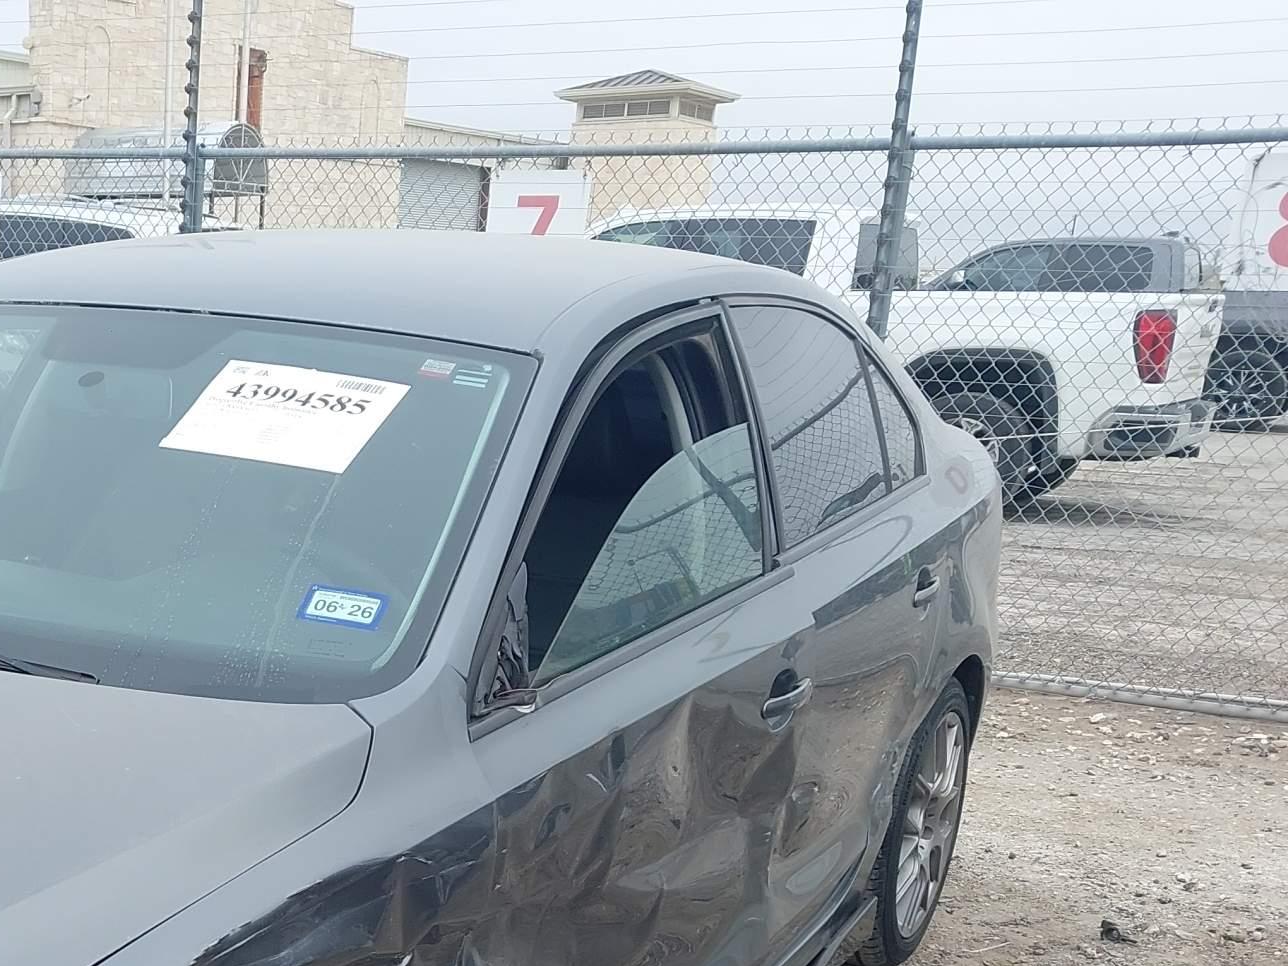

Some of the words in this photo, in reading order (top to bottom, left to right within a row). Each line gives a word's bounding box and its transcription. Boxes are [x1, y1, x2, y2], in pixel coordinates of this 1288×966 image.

[517, 195, 560, 236] 7
[226, 382, 373, 415] 43994585
[314, 599, 339, 614] 06
[347, 604, 374, 619] 26
